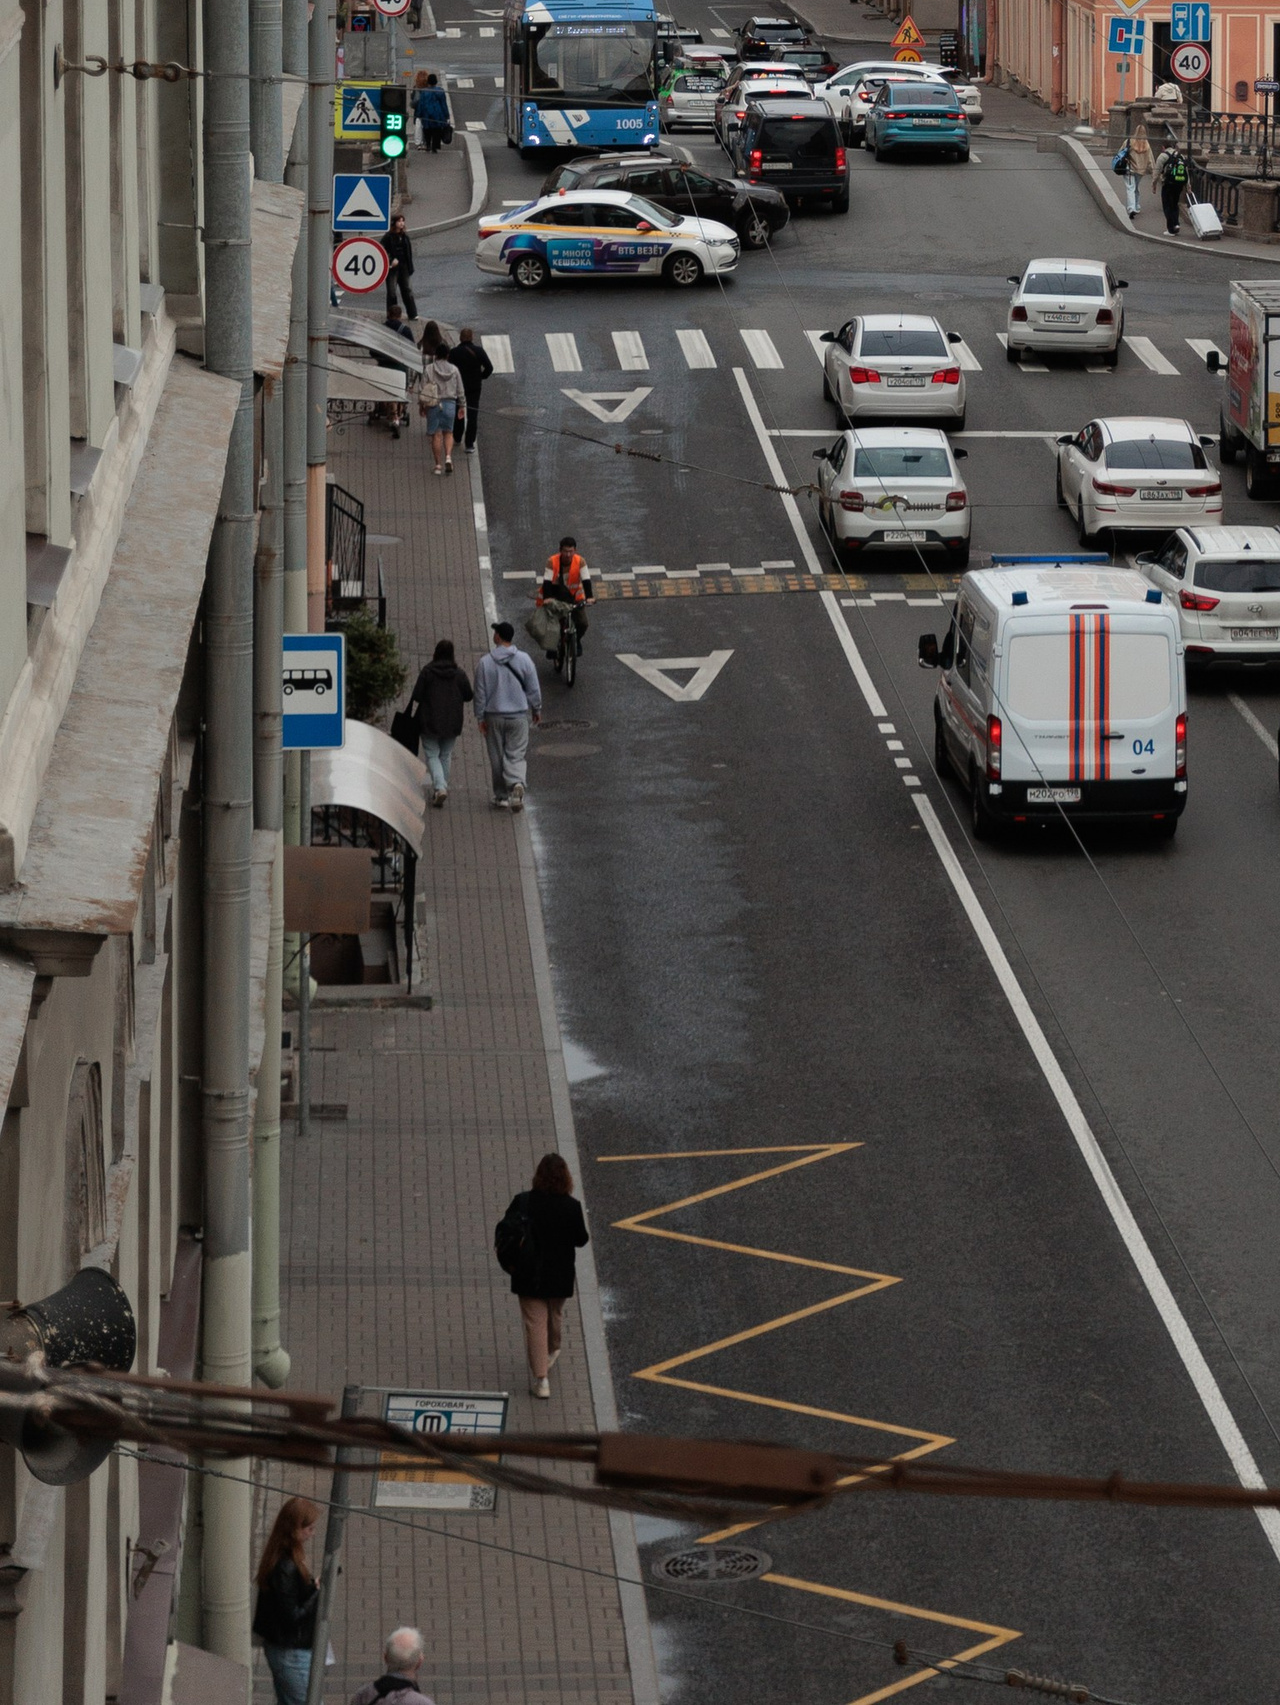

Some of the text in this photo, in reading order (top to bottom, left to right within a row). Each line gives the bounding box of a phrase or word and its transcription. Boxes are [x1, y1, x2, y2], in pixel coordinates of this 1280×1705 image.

[1178, 55, 1201, 70] 40
[386, 114, 402, 130] 33
[616, 119, 643, 129] 1005
[618, 245, 664, 256] ВТБ ВЕЗЁТ
[344, 255, 376, 276] 40
[1133, 739, 1155, 755] 04
[415, 1400, 464, 1409] ГОРОХОВАЯ
